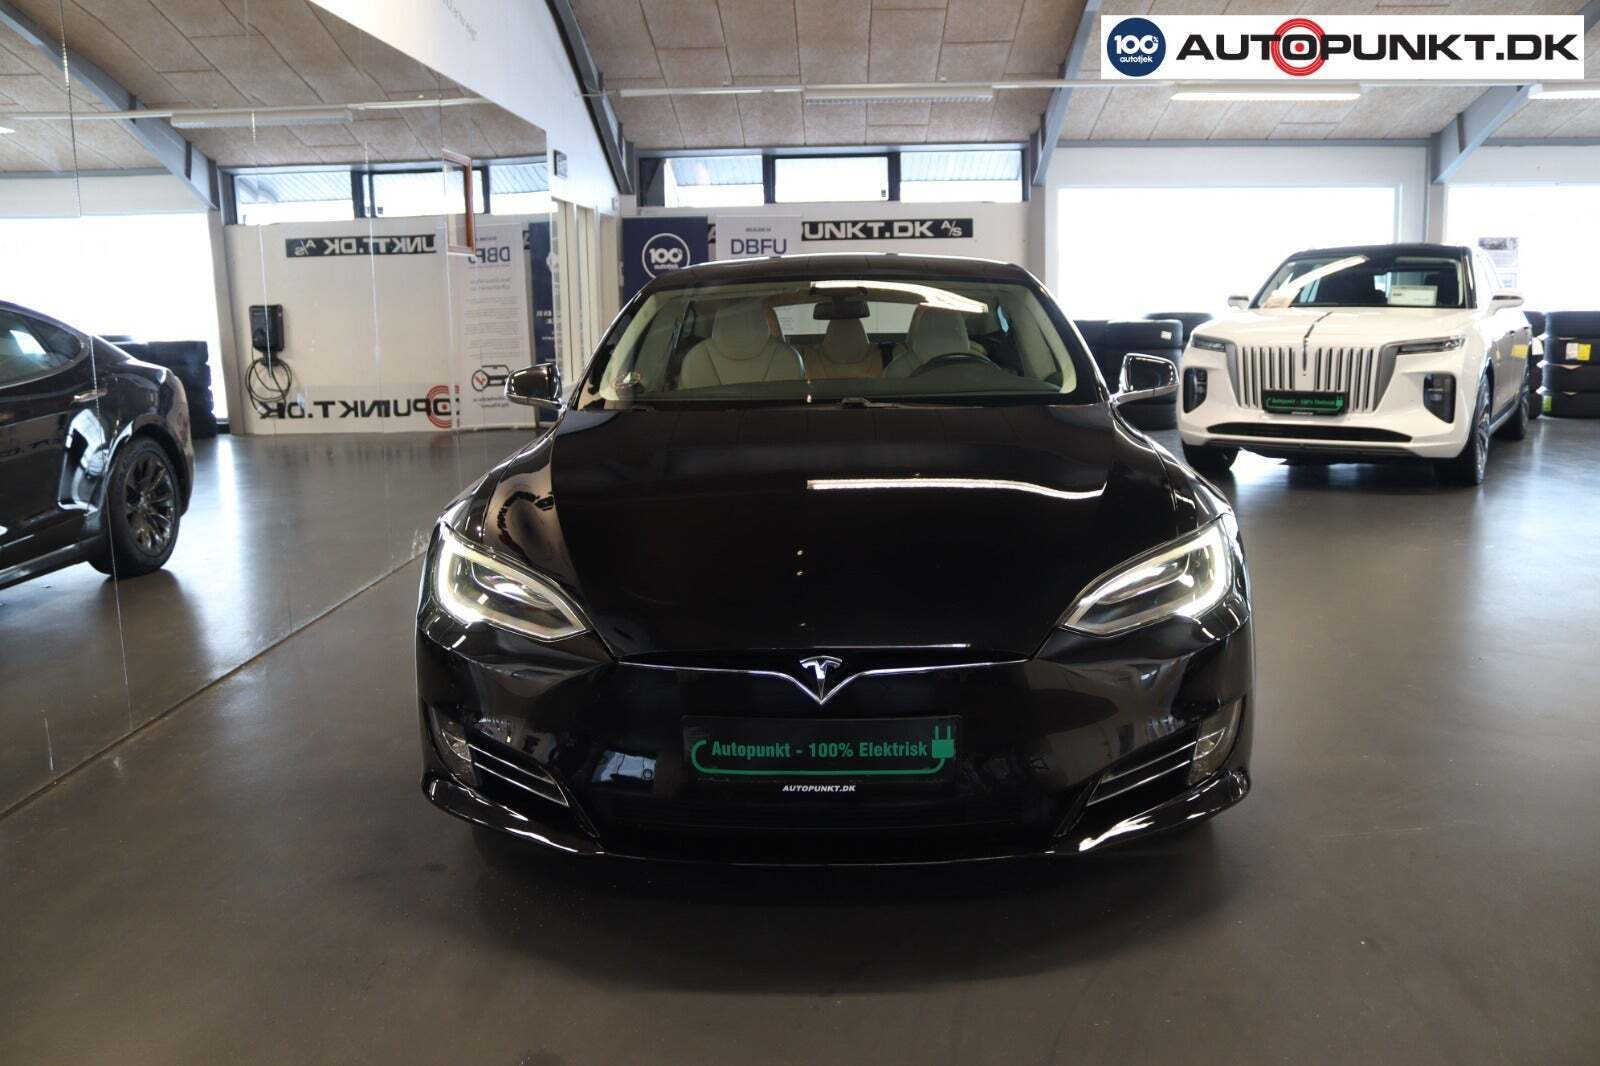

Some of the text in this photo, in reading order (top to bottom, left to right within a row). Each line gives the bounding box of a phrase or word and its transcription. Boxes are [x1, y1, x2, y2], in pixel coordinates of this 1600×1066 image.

[802, 220, 963, 240] UNKT.DK A/S
[731, 238, 787, 255] DBFU
[711, 740, 791, 760] Autopunkt
[809, 742, 854, 758] 100%
[859, 740, 928, 758] Elektrisk
[782, 784, 856, 792] AUTOPUNKT.DK
